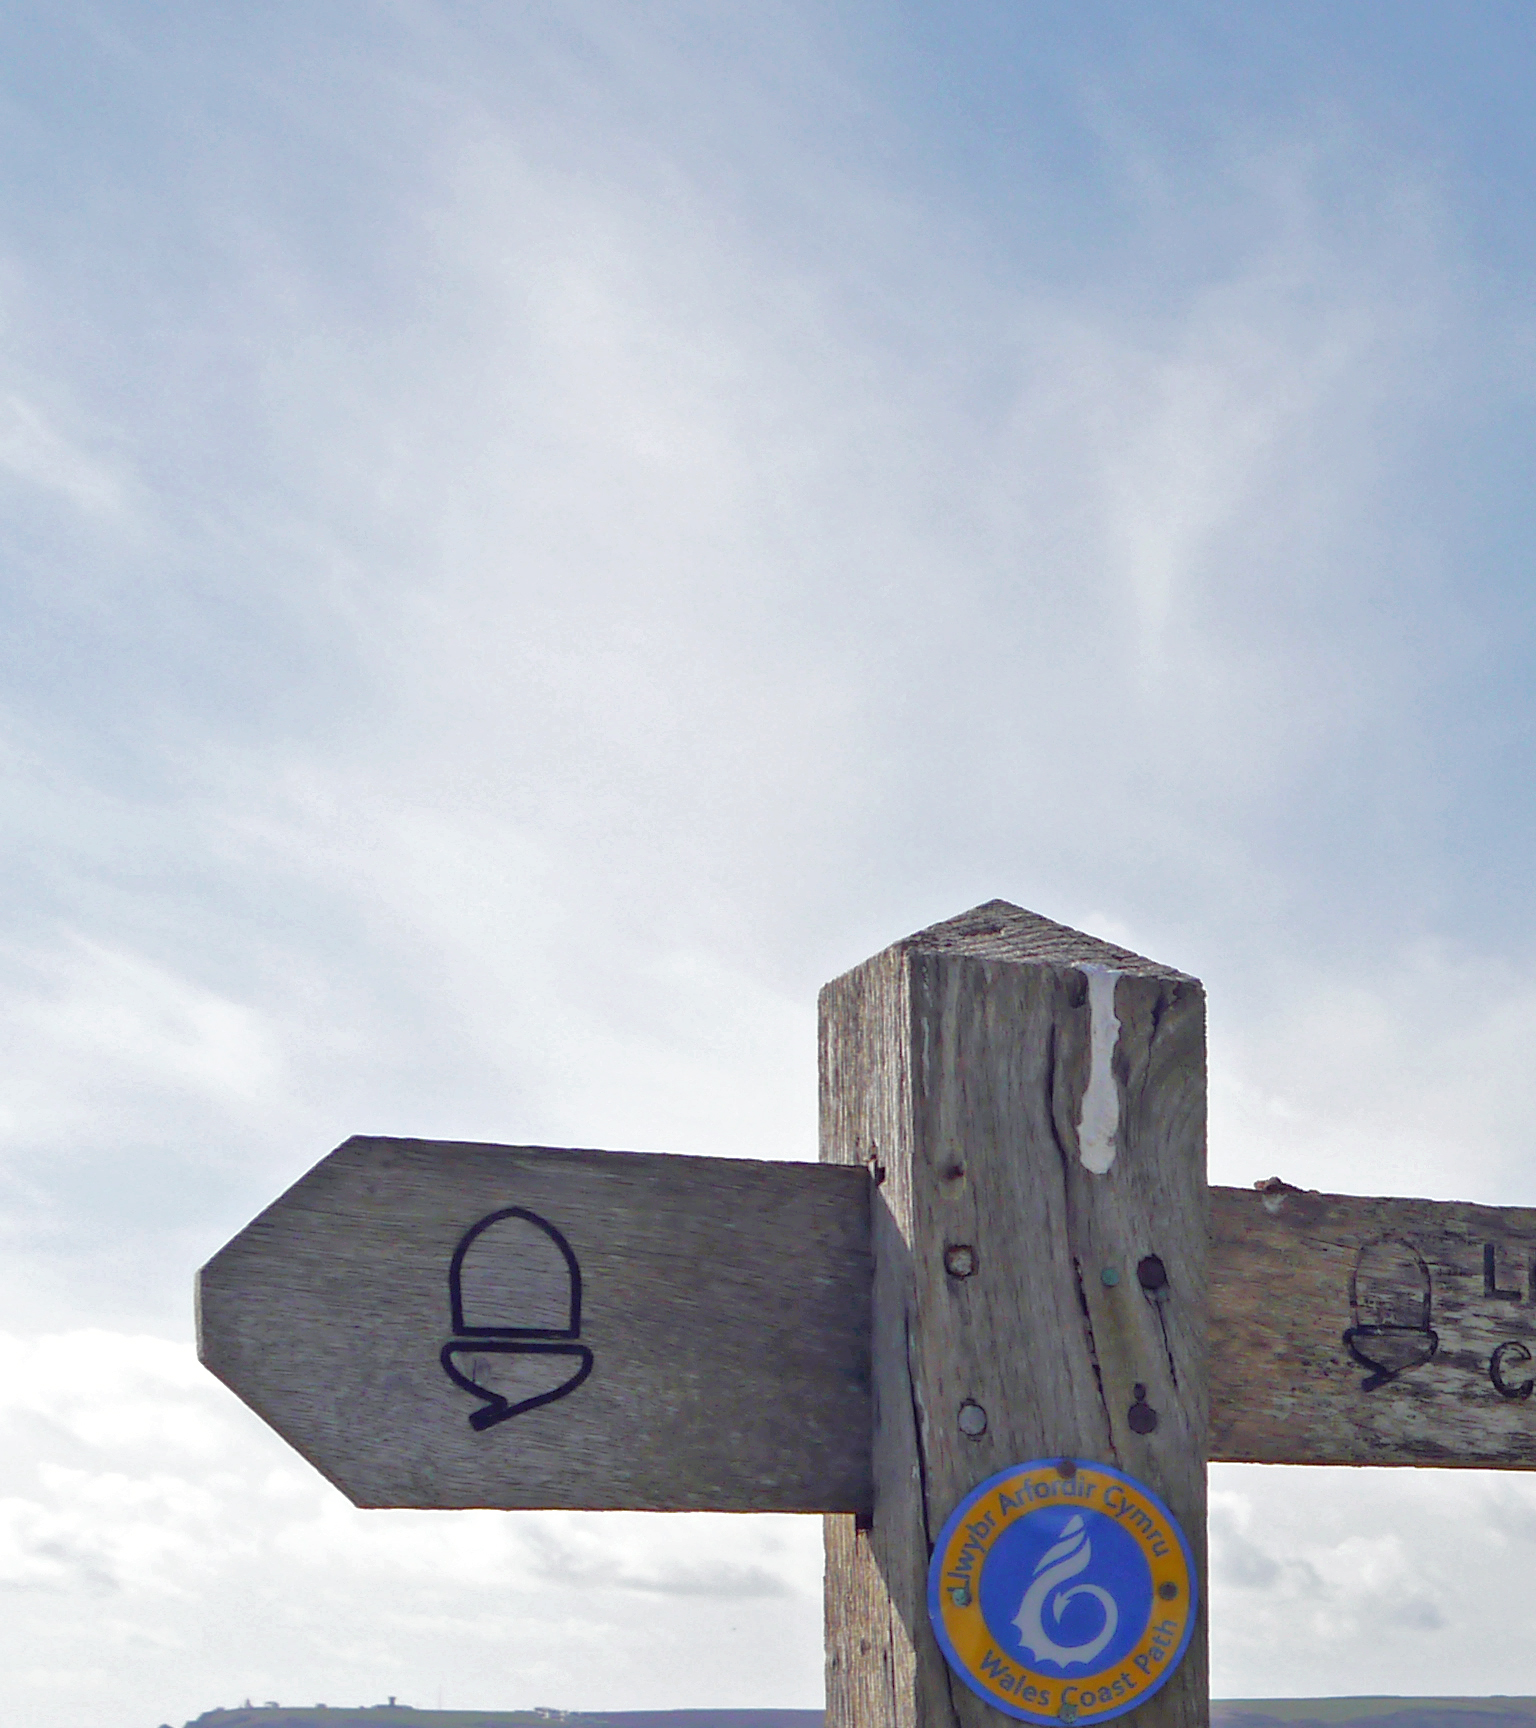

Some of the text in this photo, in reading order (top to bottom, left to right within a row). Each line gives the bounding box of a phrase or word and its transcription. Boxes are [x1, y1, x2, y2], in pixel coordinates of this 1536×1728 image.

[998, 1476, 1097, 1517] Arfordir
[1103, 1484, 1171, 1559] Cymru
[978, 1618, 1179, 1708] Wales Coast Path
